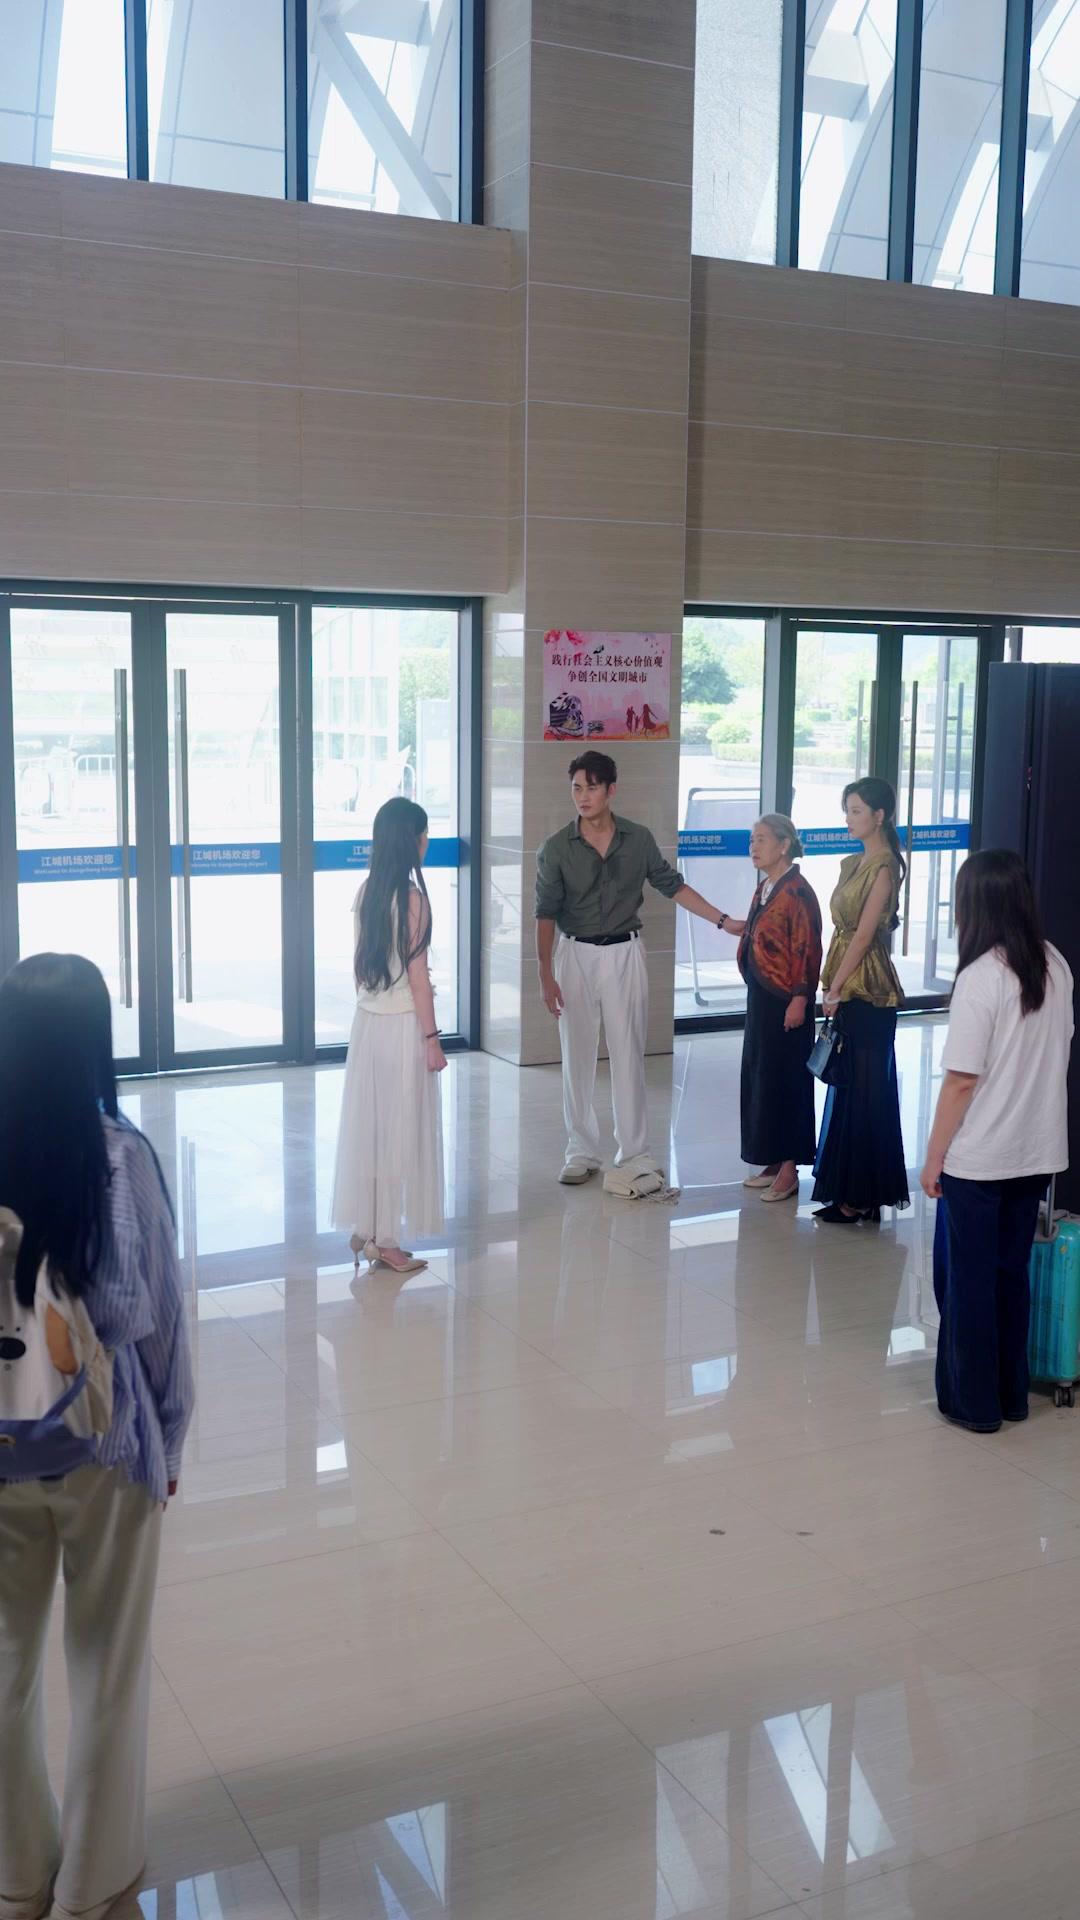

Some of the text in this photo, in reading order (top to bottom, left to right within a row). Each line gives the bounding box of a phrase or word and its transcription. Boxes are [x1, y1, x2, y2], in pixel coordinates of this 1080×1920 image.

[551, 654, 663, 668] 践行社会主义核心价值观
[567, 670, 648, 683] 争创全国文明城市
[41, 854, 114, 867] 江城机场欢迎您
[192, 849, 261, 861] 江城机场欢迎您
